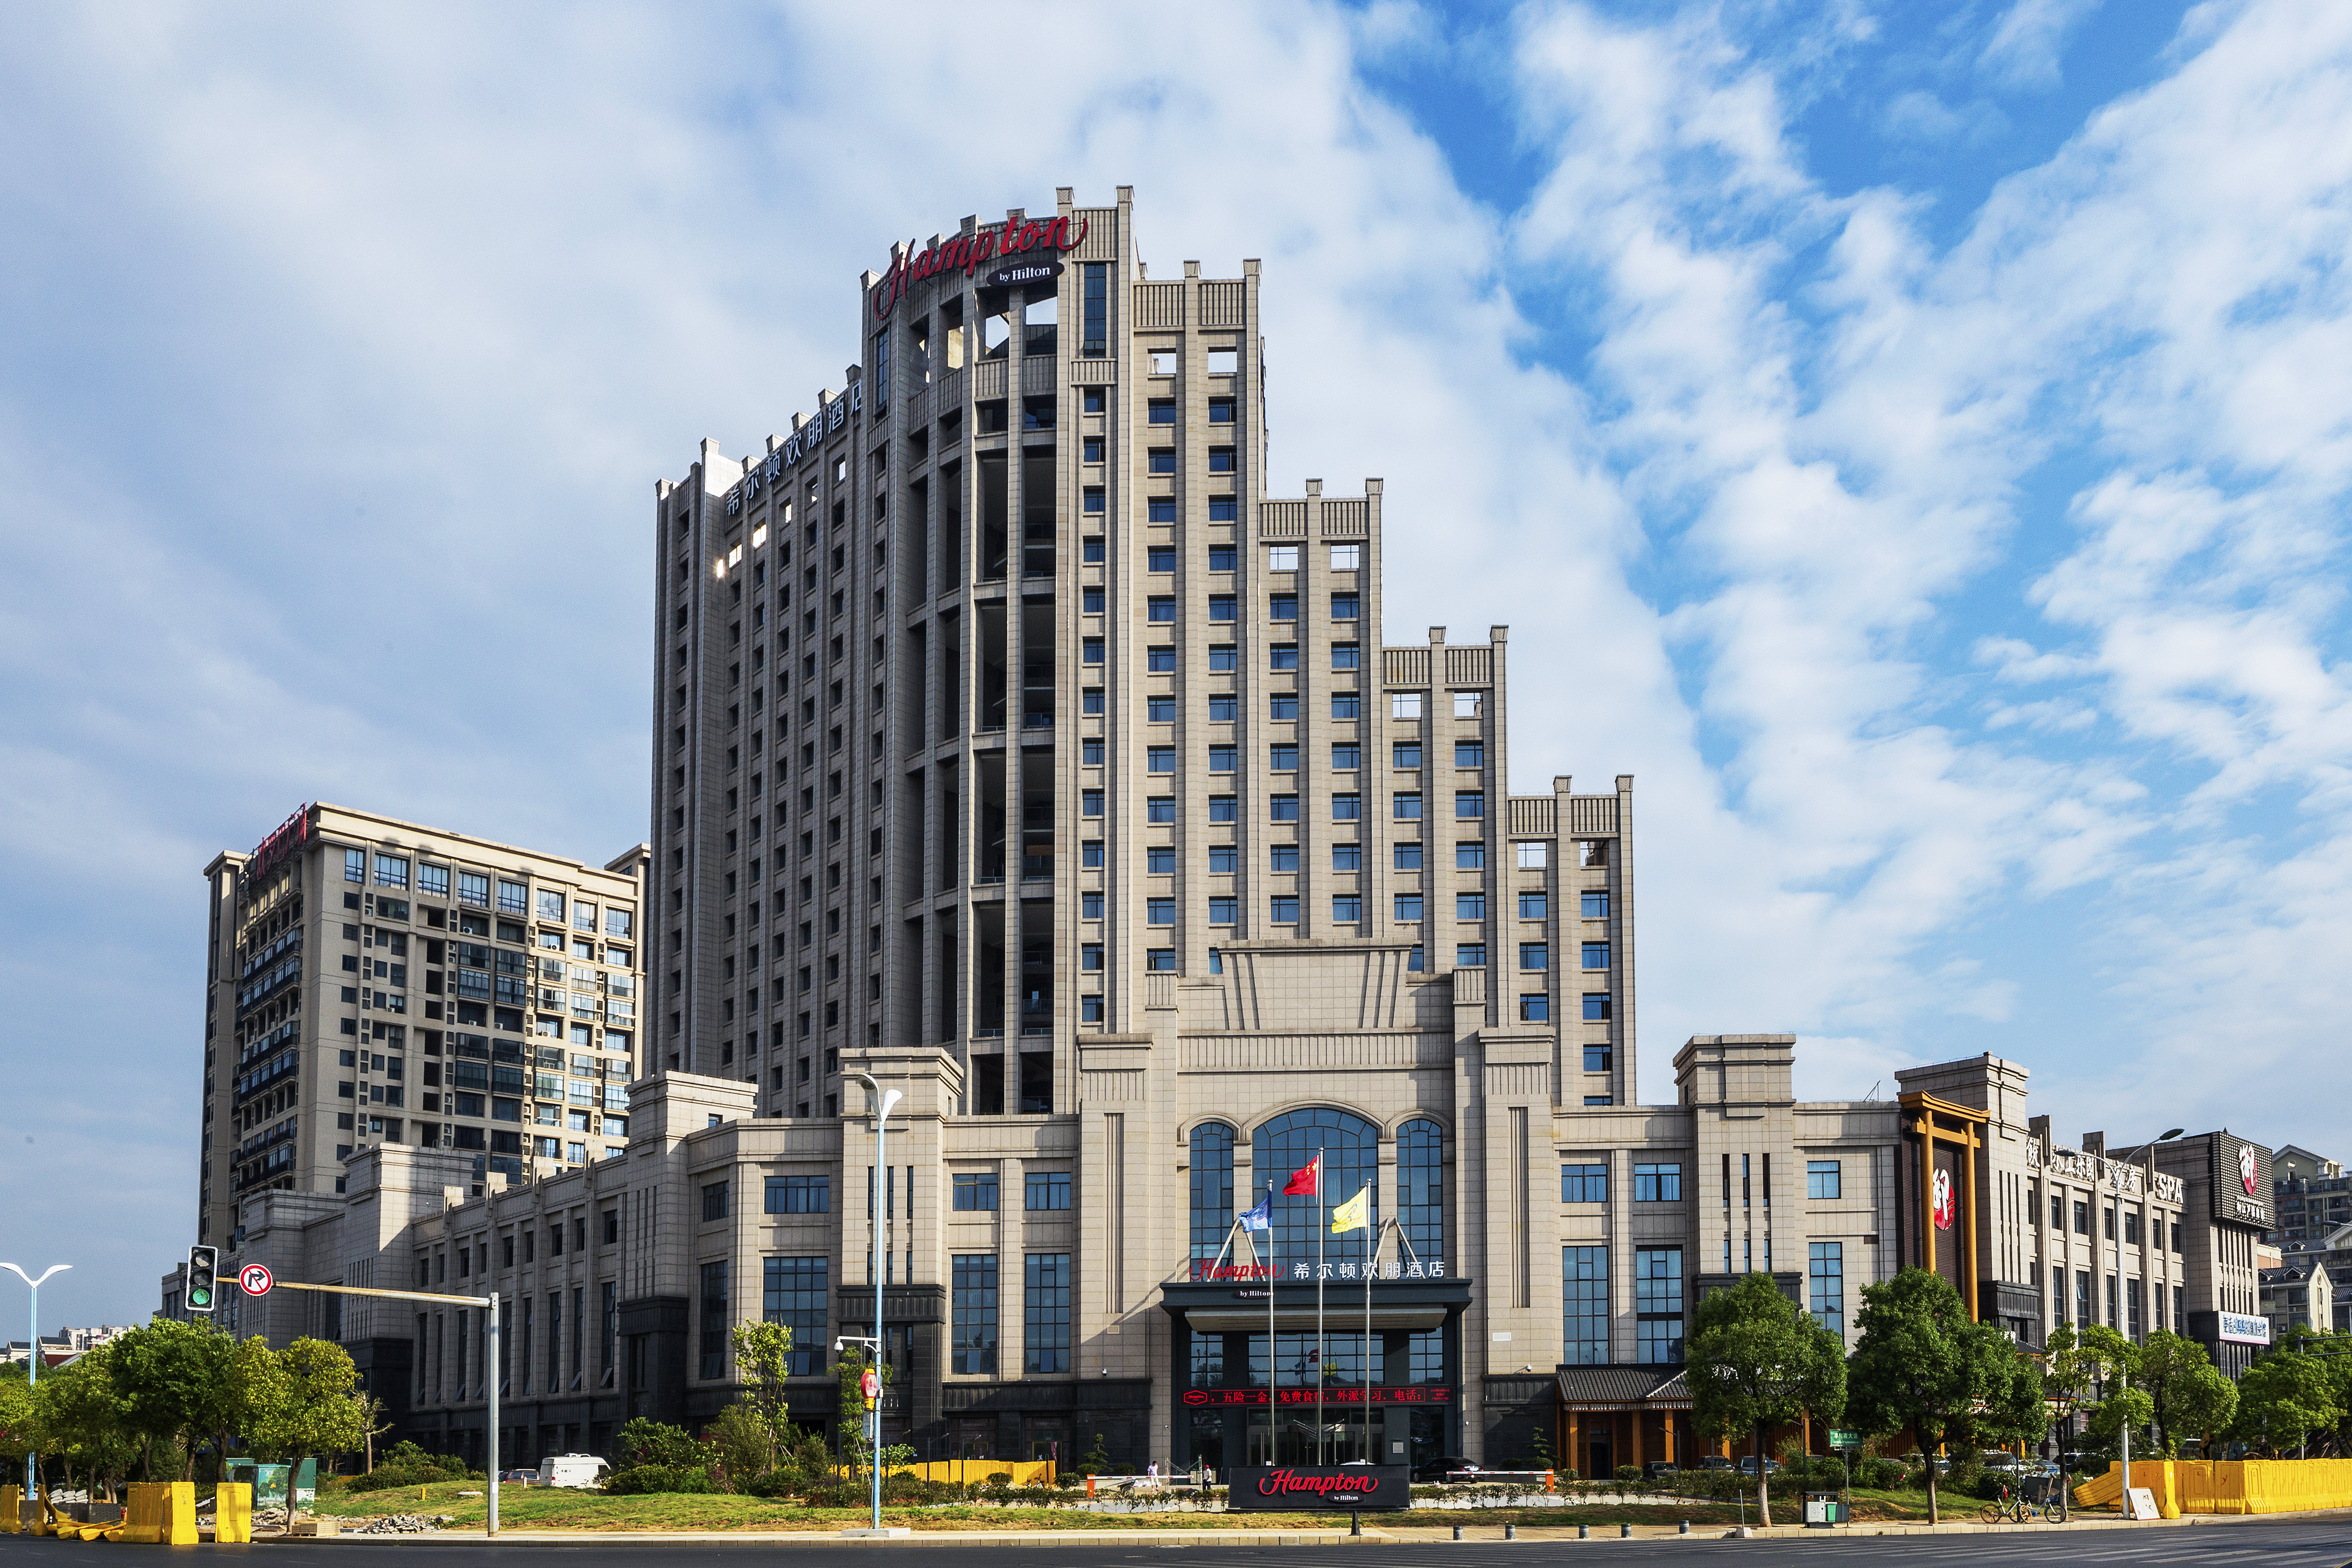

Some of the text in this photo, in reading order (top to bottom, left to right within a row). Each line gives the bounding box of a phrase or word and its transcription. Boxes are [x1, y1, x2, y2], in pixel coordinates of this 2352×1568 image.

[875, 216, 1089, 320] Hampton
[999, 265, 1051, 282] by Hilton
[2158, 1174, 2183, 1204] SPA
[1189, 1257, 1285, 1281] Hampton
[1294, 1261, 1445, 1279] 希尔顿欢朋酒店
[1259, 1469, 1378, 1496] Hampton
